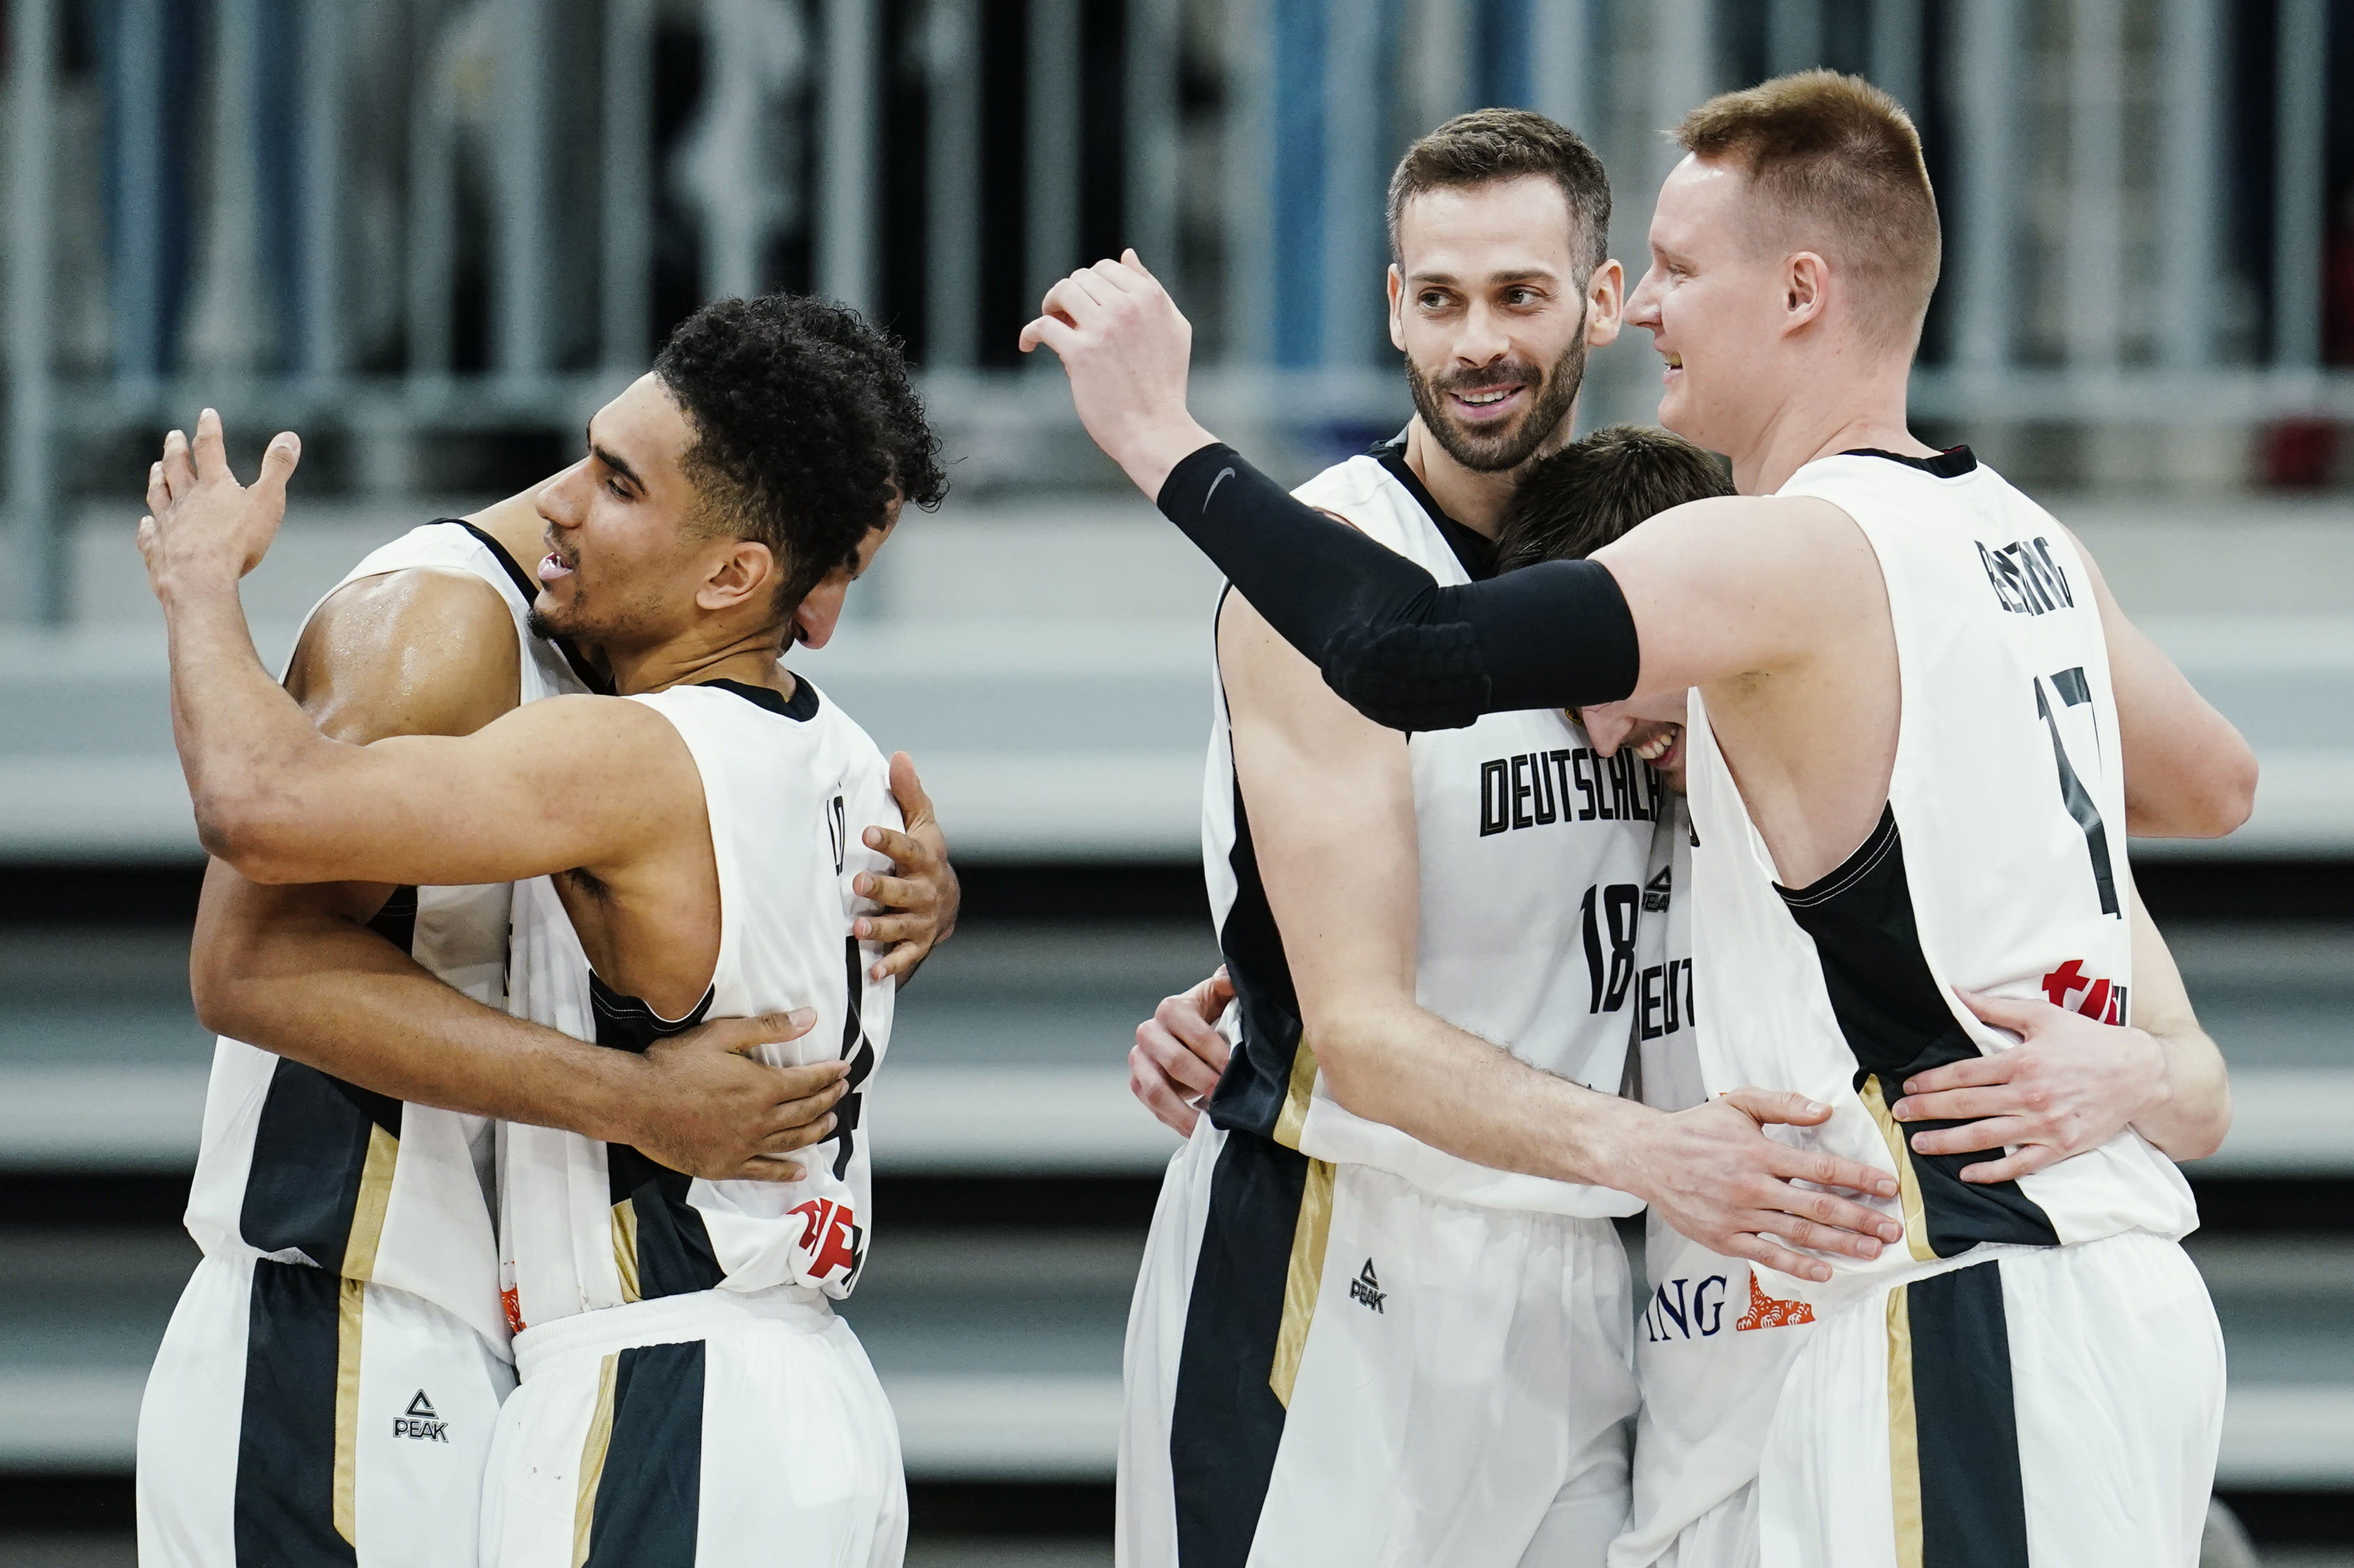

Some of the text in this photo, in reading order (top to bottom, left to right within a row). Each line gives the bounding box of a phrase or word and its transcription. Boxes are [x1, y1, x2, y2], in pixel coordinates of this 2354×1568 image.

[1580, 884, 1640, 1014] 18
[1634, 957, 1694, 1041] EUT
[1349, 1277, 1387, 1314] PEAK
[393, 1417, 449, 1443] PEAK
